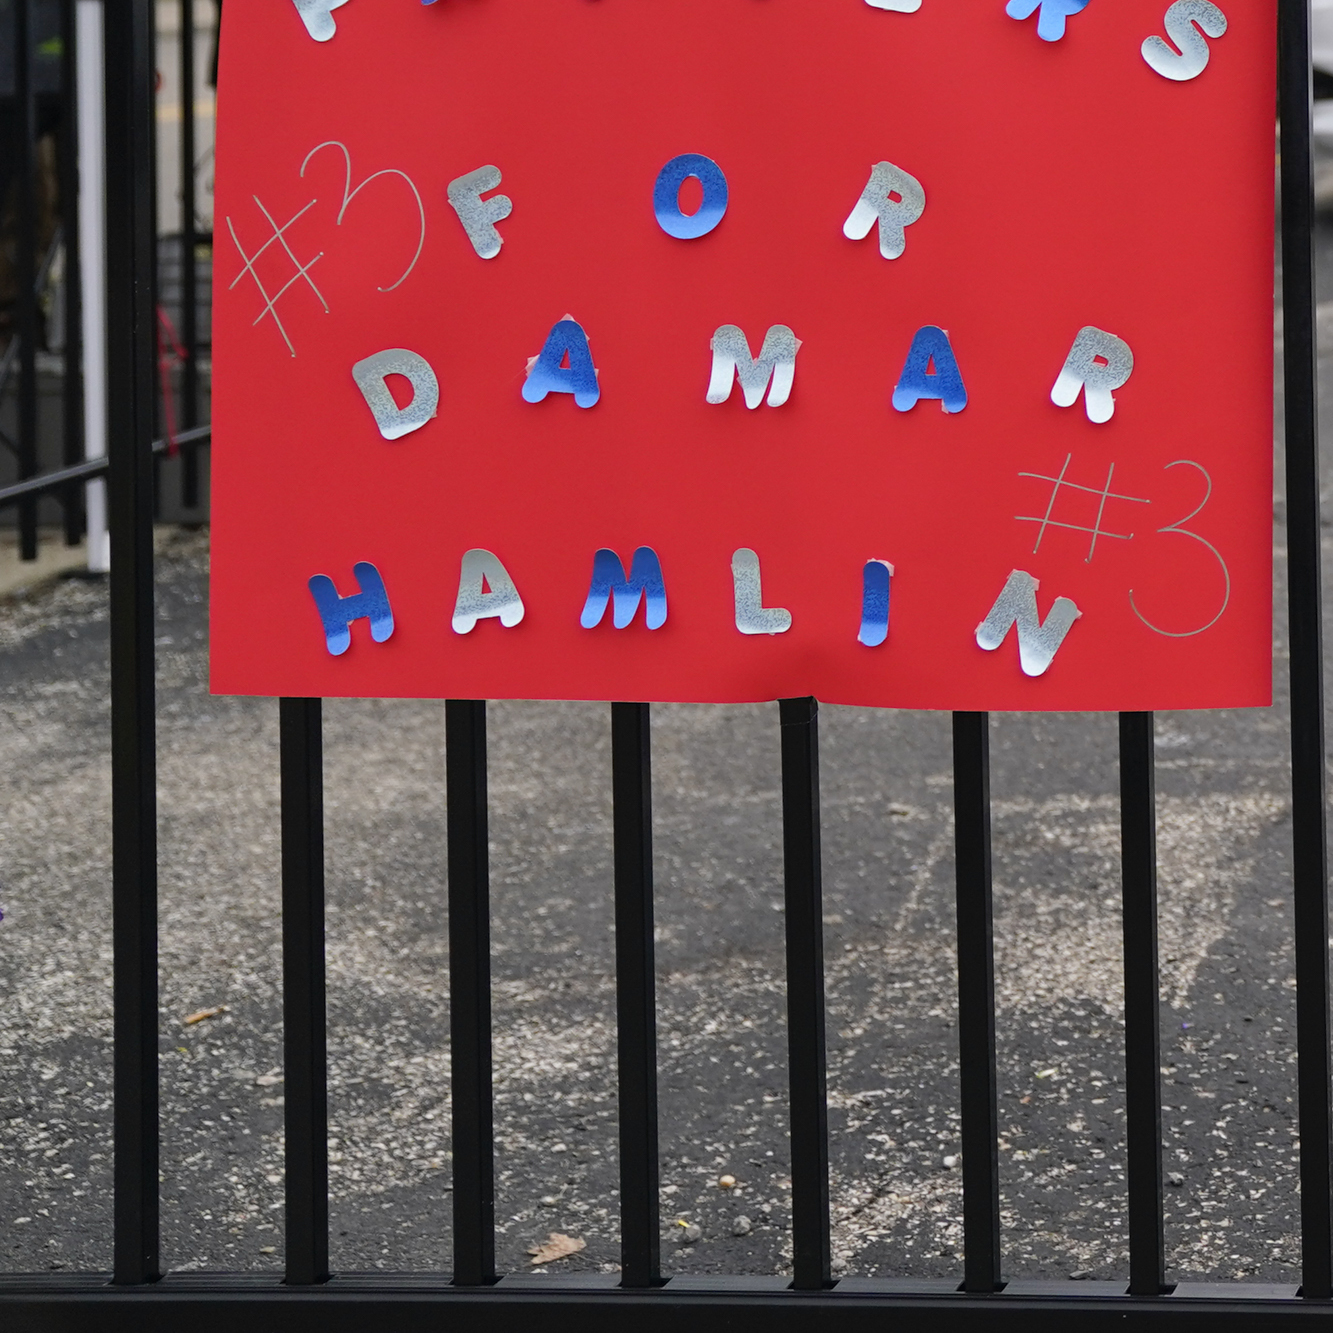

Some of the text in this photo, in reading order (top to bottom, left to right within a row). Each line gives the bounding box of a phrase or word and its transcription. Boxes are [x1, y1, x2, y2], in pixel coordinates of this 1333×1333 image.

[226, 140, 426, 358] #3
[447, 152, 926, 260] FOR
[351, 317, 1134, 440] DAMAR
[1013, 452, 1230, 637] #3
[307, 545, 1083, 678] HAMLIN
